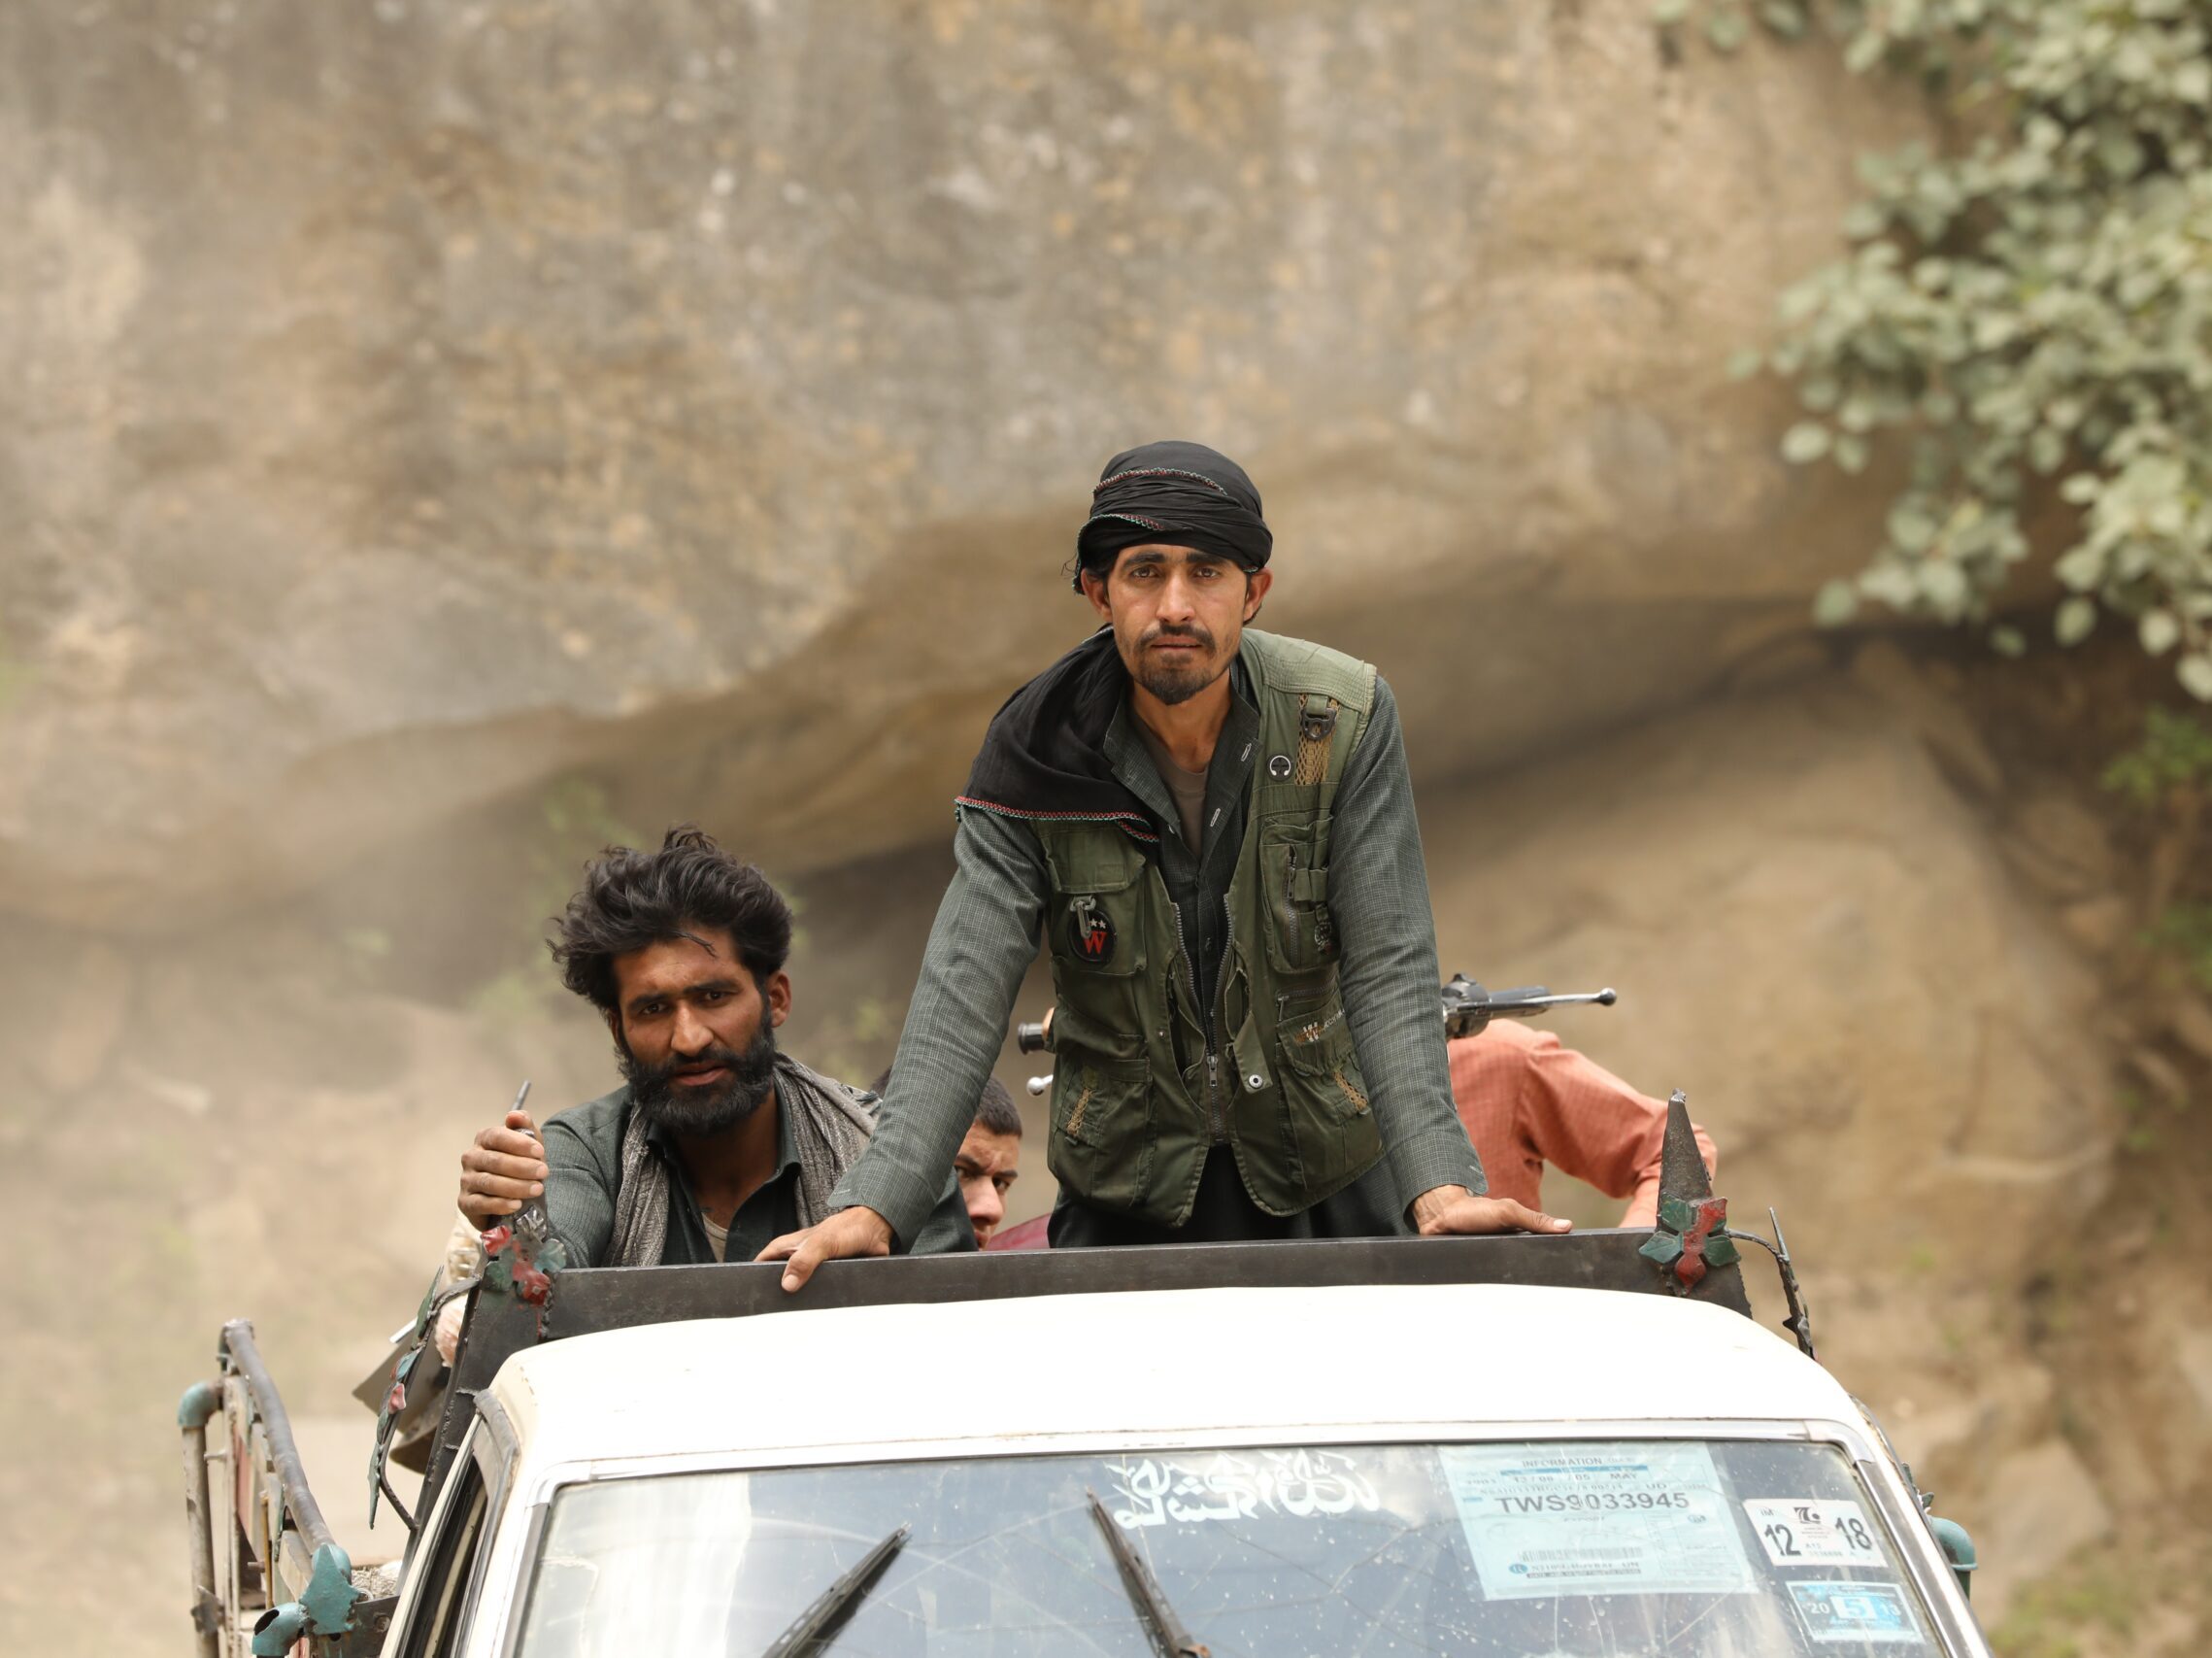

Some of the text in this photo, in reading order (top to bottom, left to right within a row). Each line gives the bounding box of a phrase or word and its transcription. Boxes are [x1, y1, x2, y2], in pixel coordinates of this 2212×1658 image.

[1522, 1457, 1602, 1468] INFORMATION
[1493, 1492, 1690, 1513] TWS9033945
[1764, 1524, 1802, 1556] 12
[1834, 1517, 1873, 1550] 18
[1807, 1602, 1830, 1614] 20
[1843, 1598, 1866, 1617] 5
